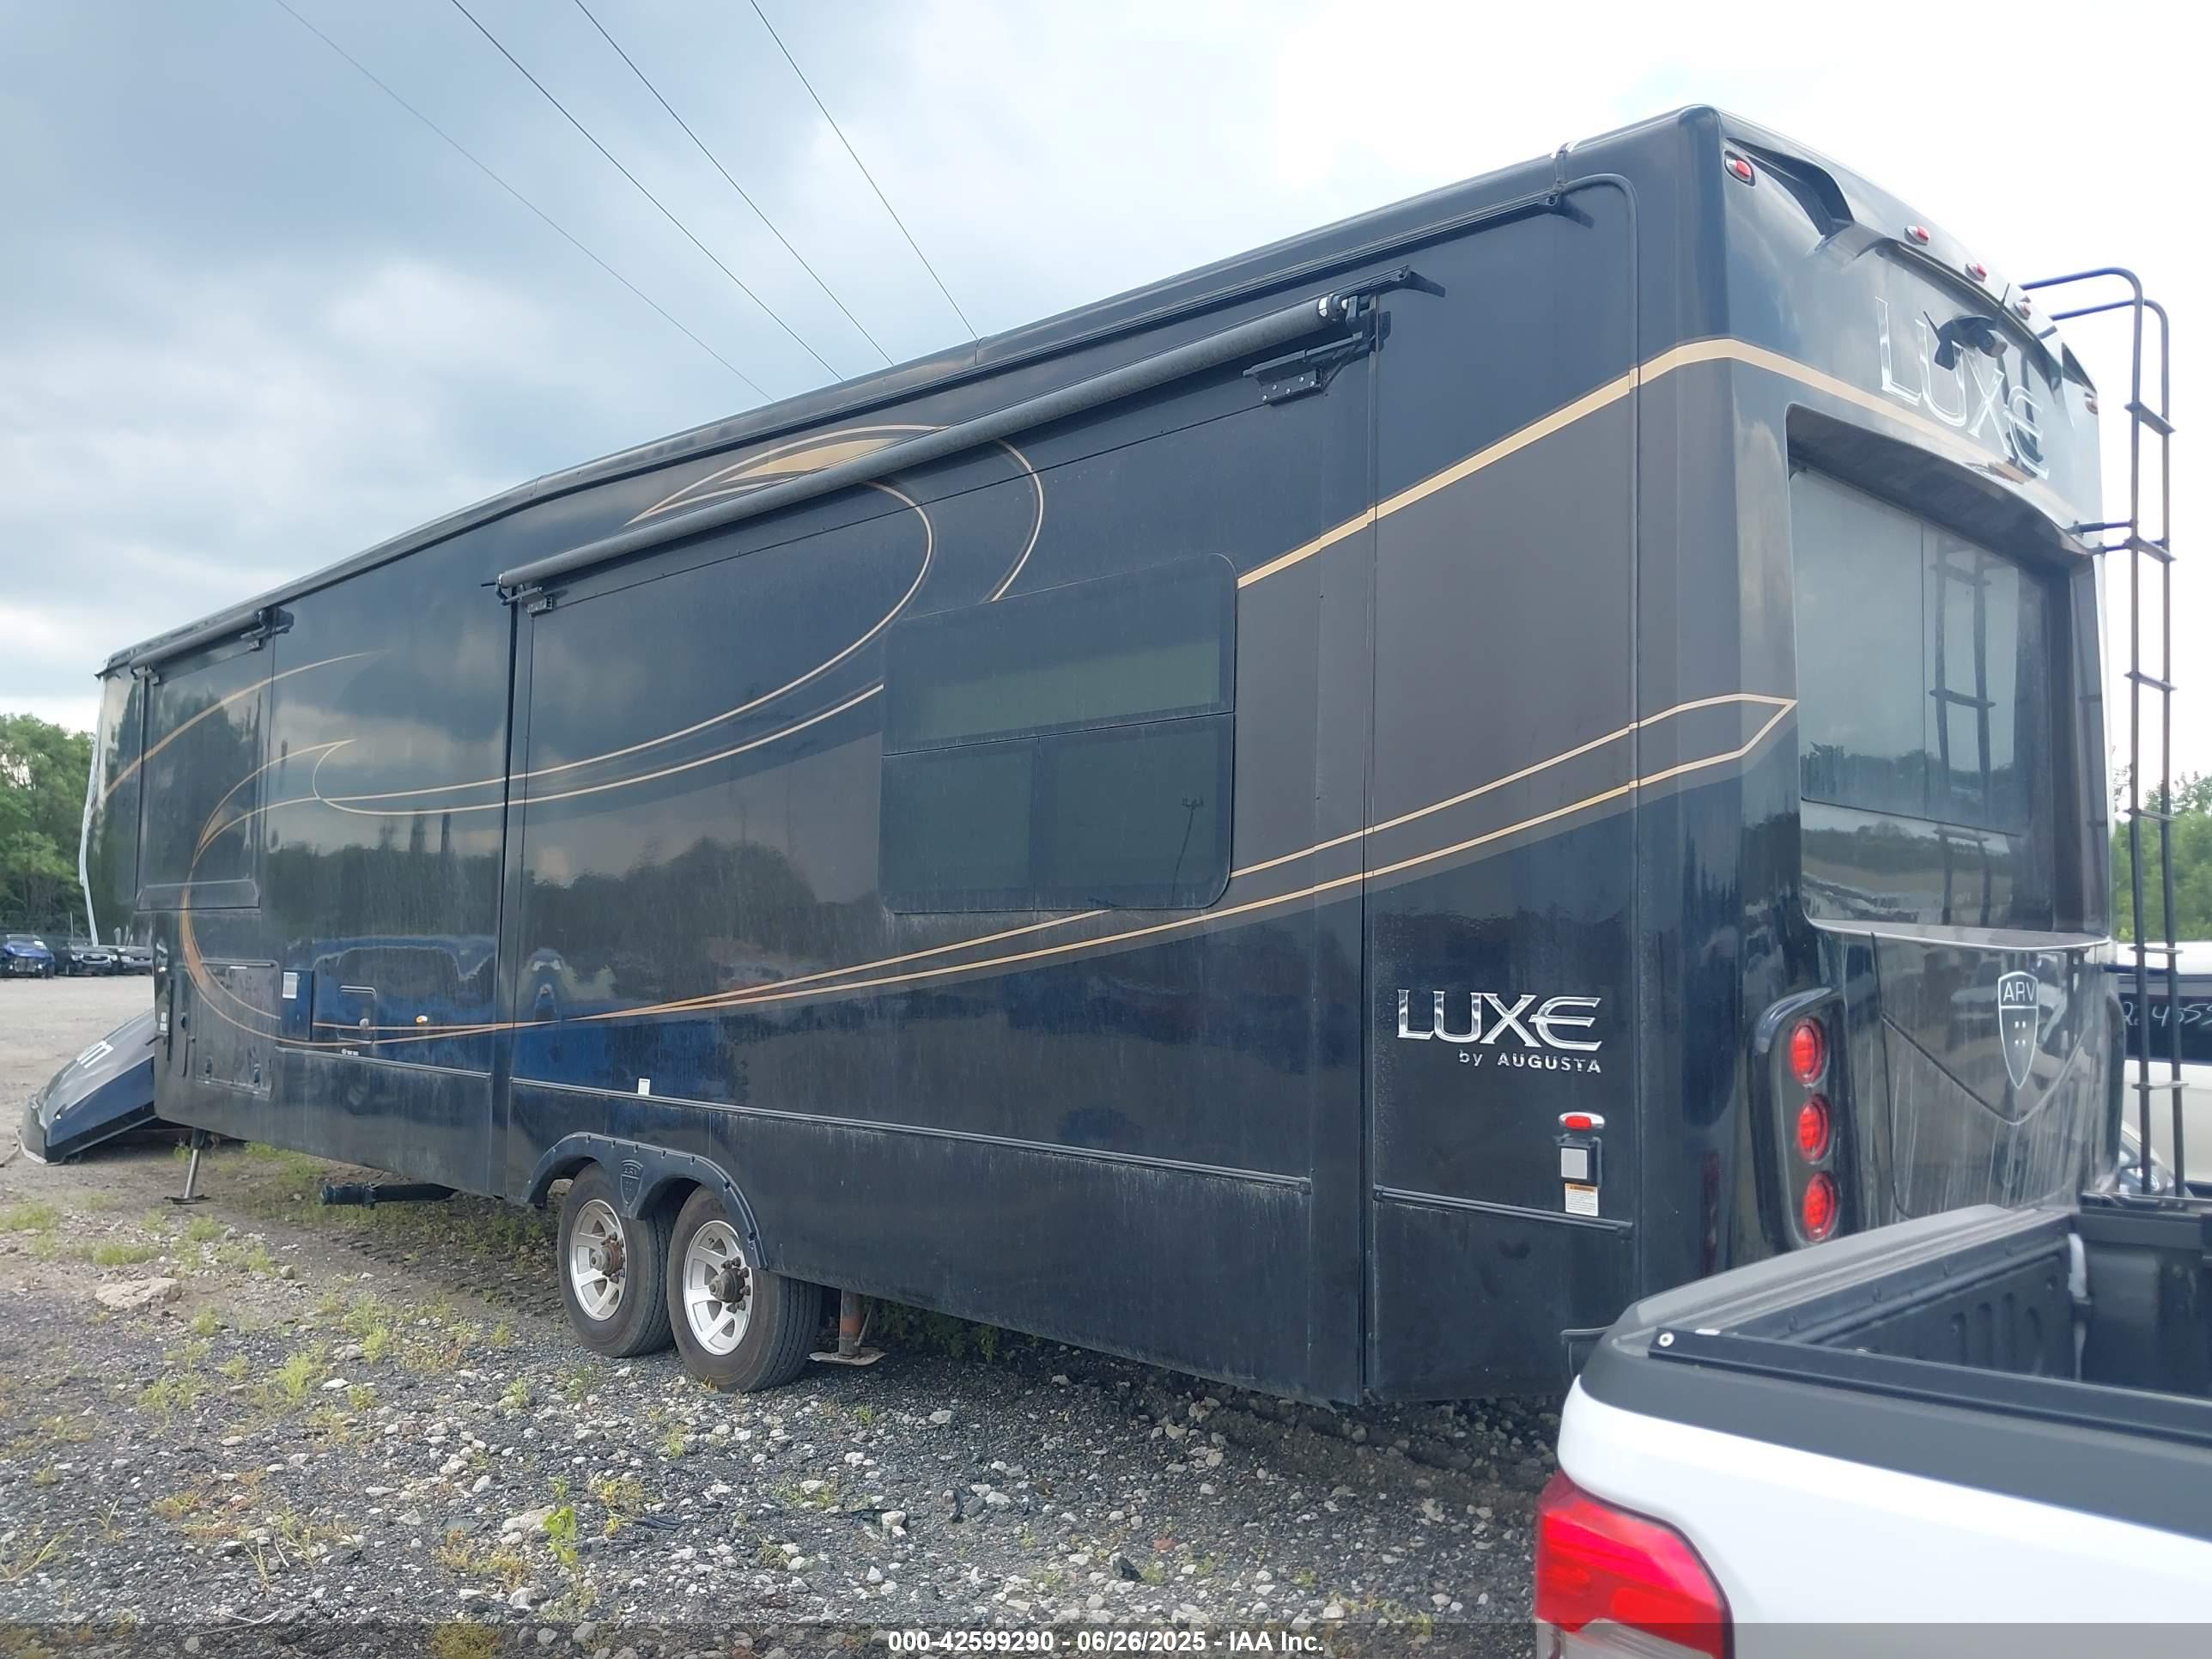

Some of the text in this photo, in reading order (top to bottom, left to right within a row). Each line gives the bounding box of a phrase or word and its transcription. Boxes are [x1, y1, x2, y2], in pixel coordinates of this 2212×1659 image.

[1875, 296, 2050, 481] LUXE
[2002, 981, 2036, 1002] ARV
[1397, 988, 1602, 1051] LUXE
[1459, 1050, 1601, 1073] by AUGUSTA
